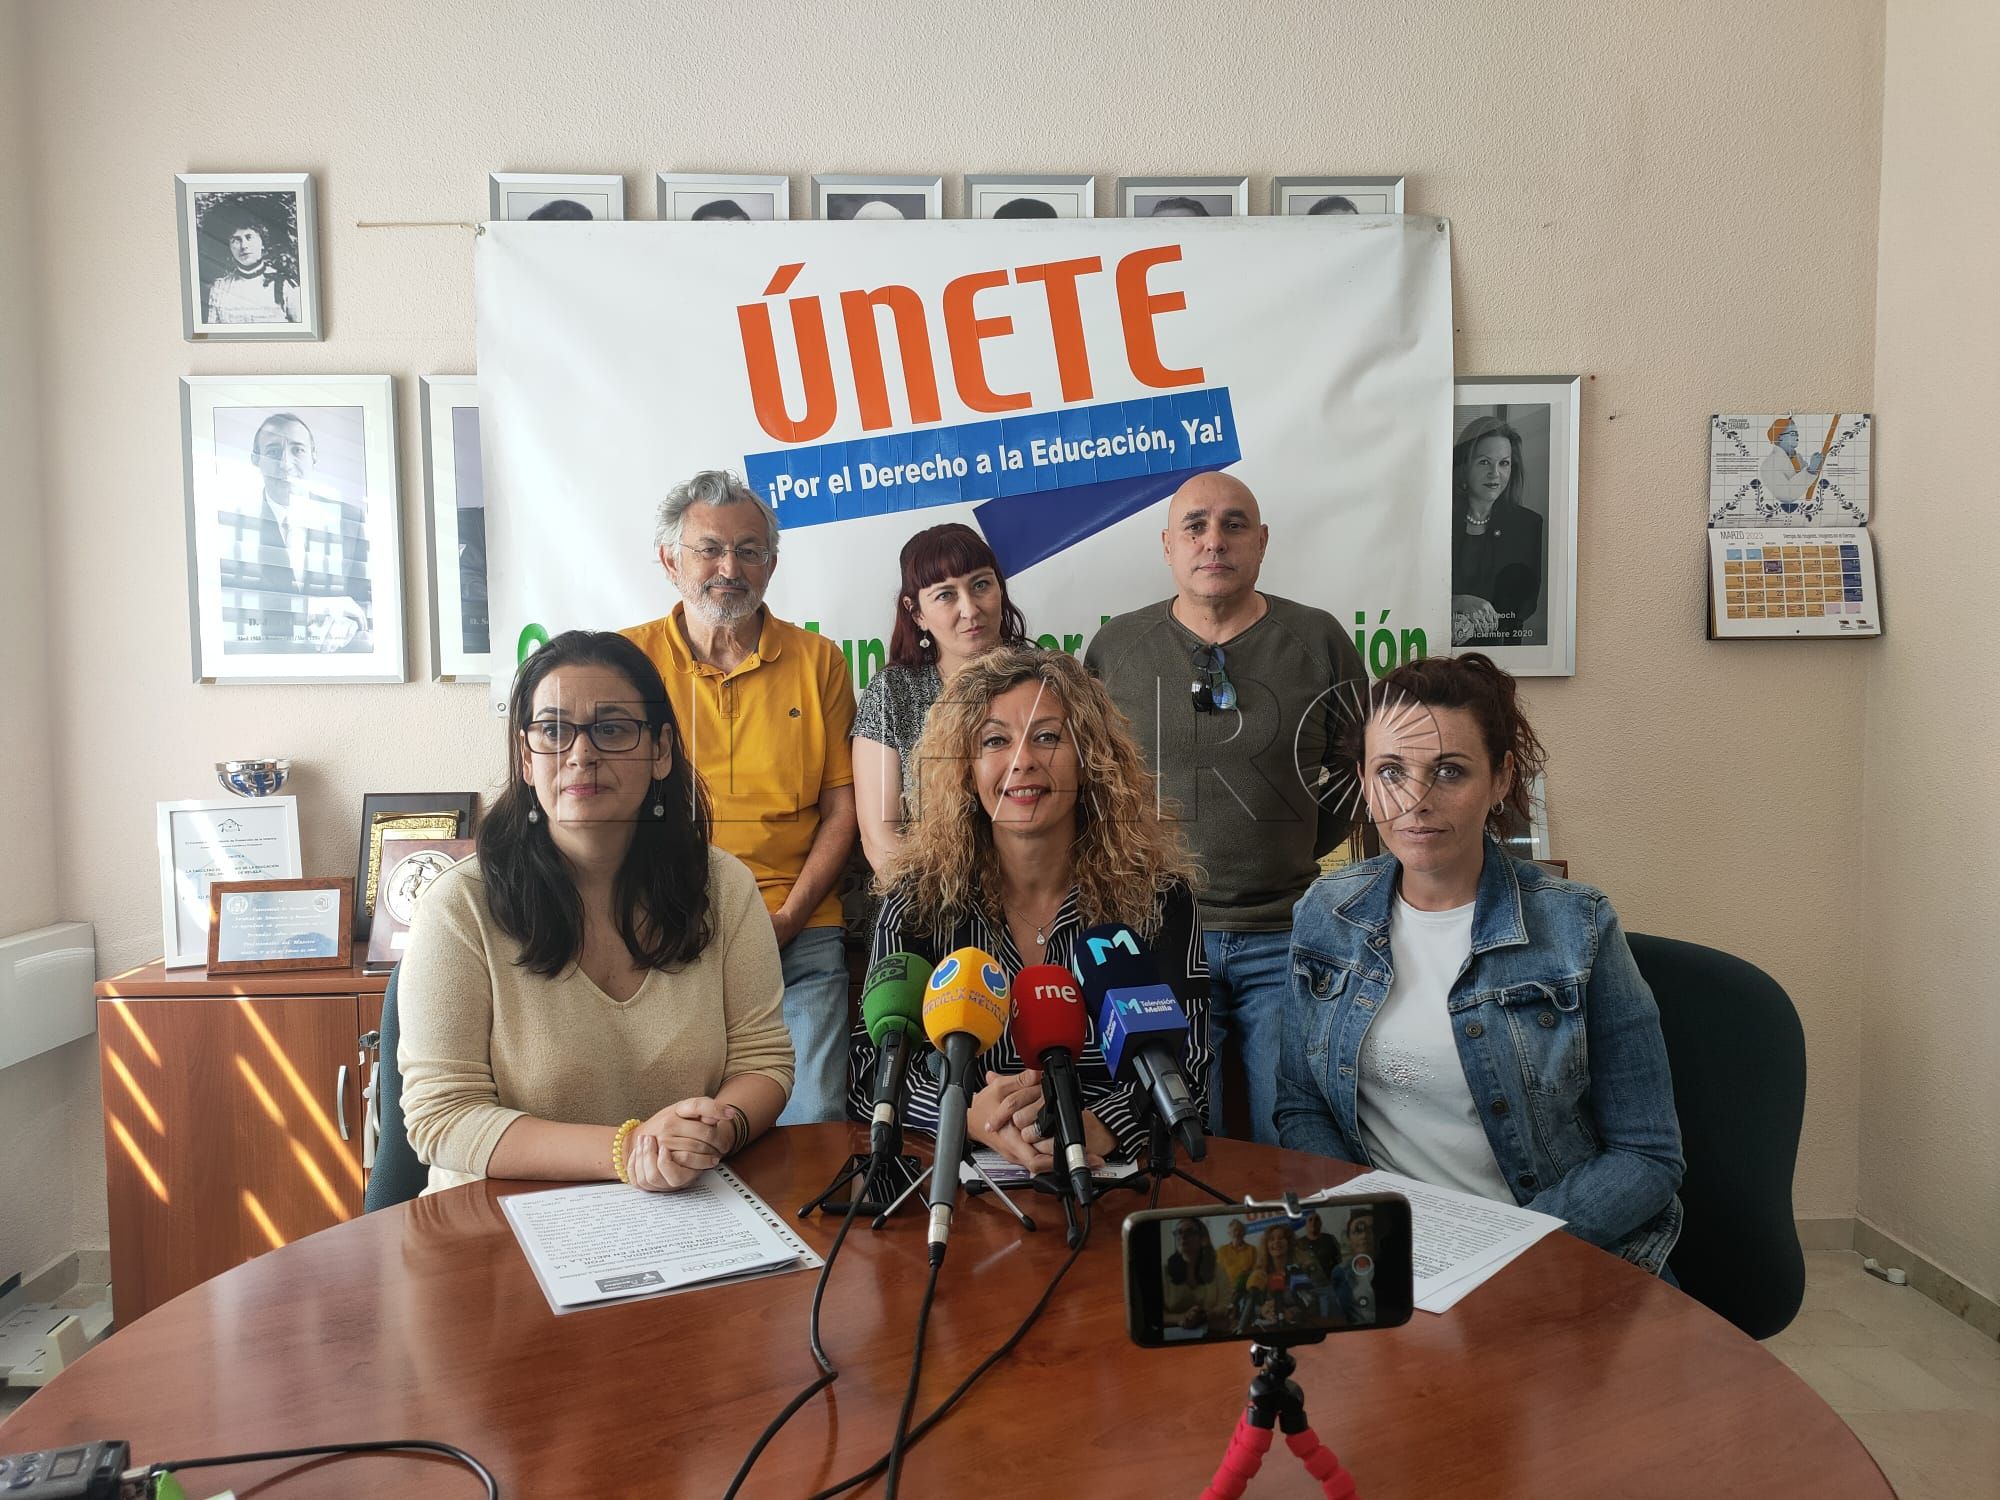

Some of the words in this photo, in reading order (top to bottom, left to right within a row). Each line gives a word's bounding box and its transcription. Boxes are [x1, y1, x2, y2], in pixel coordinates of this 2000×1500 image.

[769, 474, 820, 509] ¡Por
[828, 466, 853, 494] el
[859, 453, 968, 490] Derecho
[976, 453, 993, 474] a
[999, 445, 1024, 471] la
[1030, 425, 1175, 467] Educación,
[1180, 416, 1224, 445] Ya!
[1719, 530, 1745, 540] MARZO
[1512, 629, 1533, 638] 2020
[1034, 984, 1077, 1003] rne
[1139, 998, 1177, 1007] Televisión
[1144, 1005, 1173, 1013] Melilla
